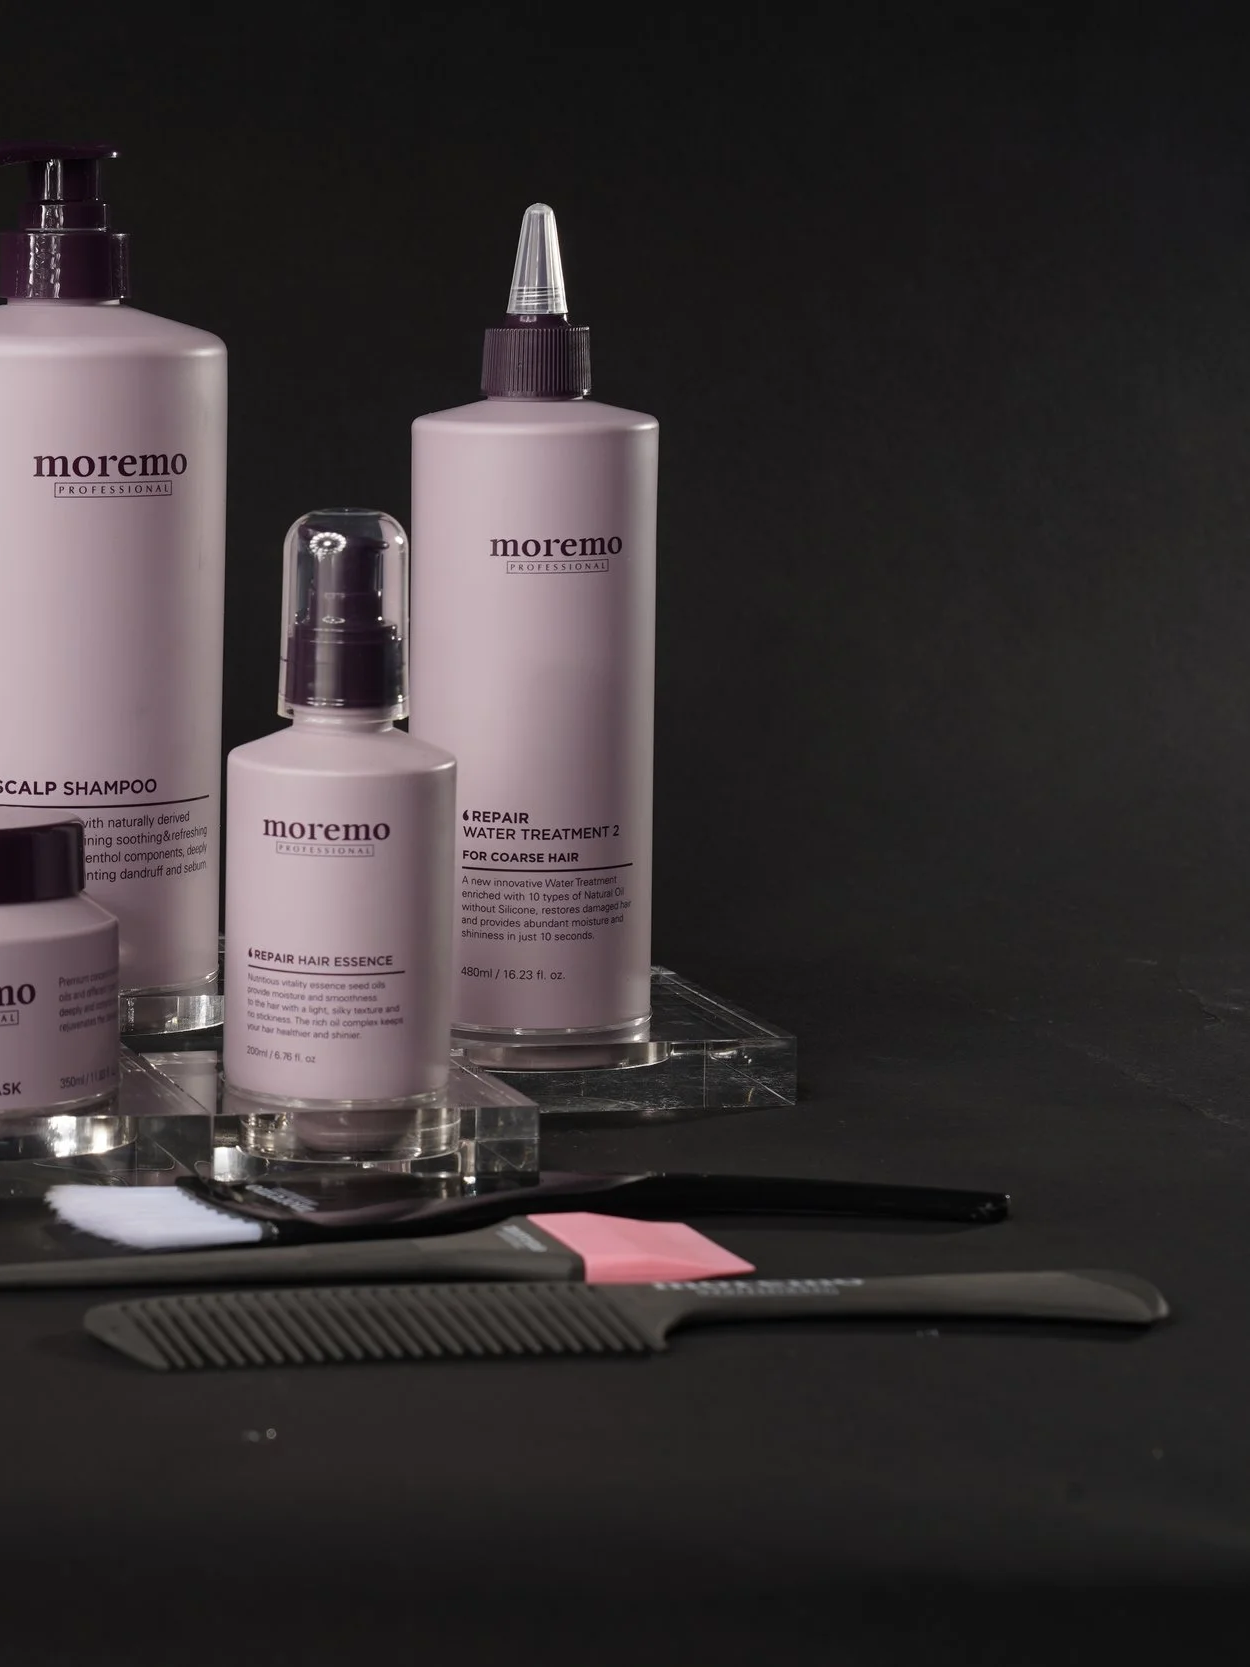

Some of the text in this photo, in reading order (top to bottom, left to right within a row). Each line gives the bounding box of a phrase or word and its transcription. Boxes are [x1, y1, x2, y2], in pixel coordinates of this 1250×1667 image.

[33, 453, 187, 477] moremo
[59, 484, 168, 494] PROFESSIONAL
[490, 536, 622, 557] moremo
[511, 563, 605, 571] PROFESSIONAL
[63, 779, 157, 796] SHAMPOO
[108, 815, 155, 828] naturally
[158, 811, 190, 825] derived
[472, 811, 529, 824] REPAIR
[263, 819, 390, 841] moremo
[463, 825, 619, 840] WATER TREATMENT 2
[84, 835, 112, 848] ining
[86, 852, 121, 863] enthol
[124, 848, 184, 863] components,
[279, 844, 371, 855] PROFESSIONAL
[462, 850, 579, 863] FOR COARSE HAIR
[87, 869, 116, 882] nting
[120, 866, 163, 879] dandruff
[166, 864, 181, 876] and
[462, 876, 617, 888] A new innovative Water Treatment
[462, 887, 624, 903] enriched with 10 types of Natural Oil
[462, 904, 495, 913] without
[498, 905, 538, 916] Silicone,
[542, 906, 580, 914] restores
[583, 902, 618, 914] damaged
[462, 914, 623, 928] and provides abundant moisture and
[462, 930, 594, 942] shininess in just 10 seconds.
[254, 949, 393, 967] REPAIR HAIR ESSENCE
[461, 967, 565, 980] 480ml / 16.23 fl. oz.
[308, 993, 323, 1001] and
